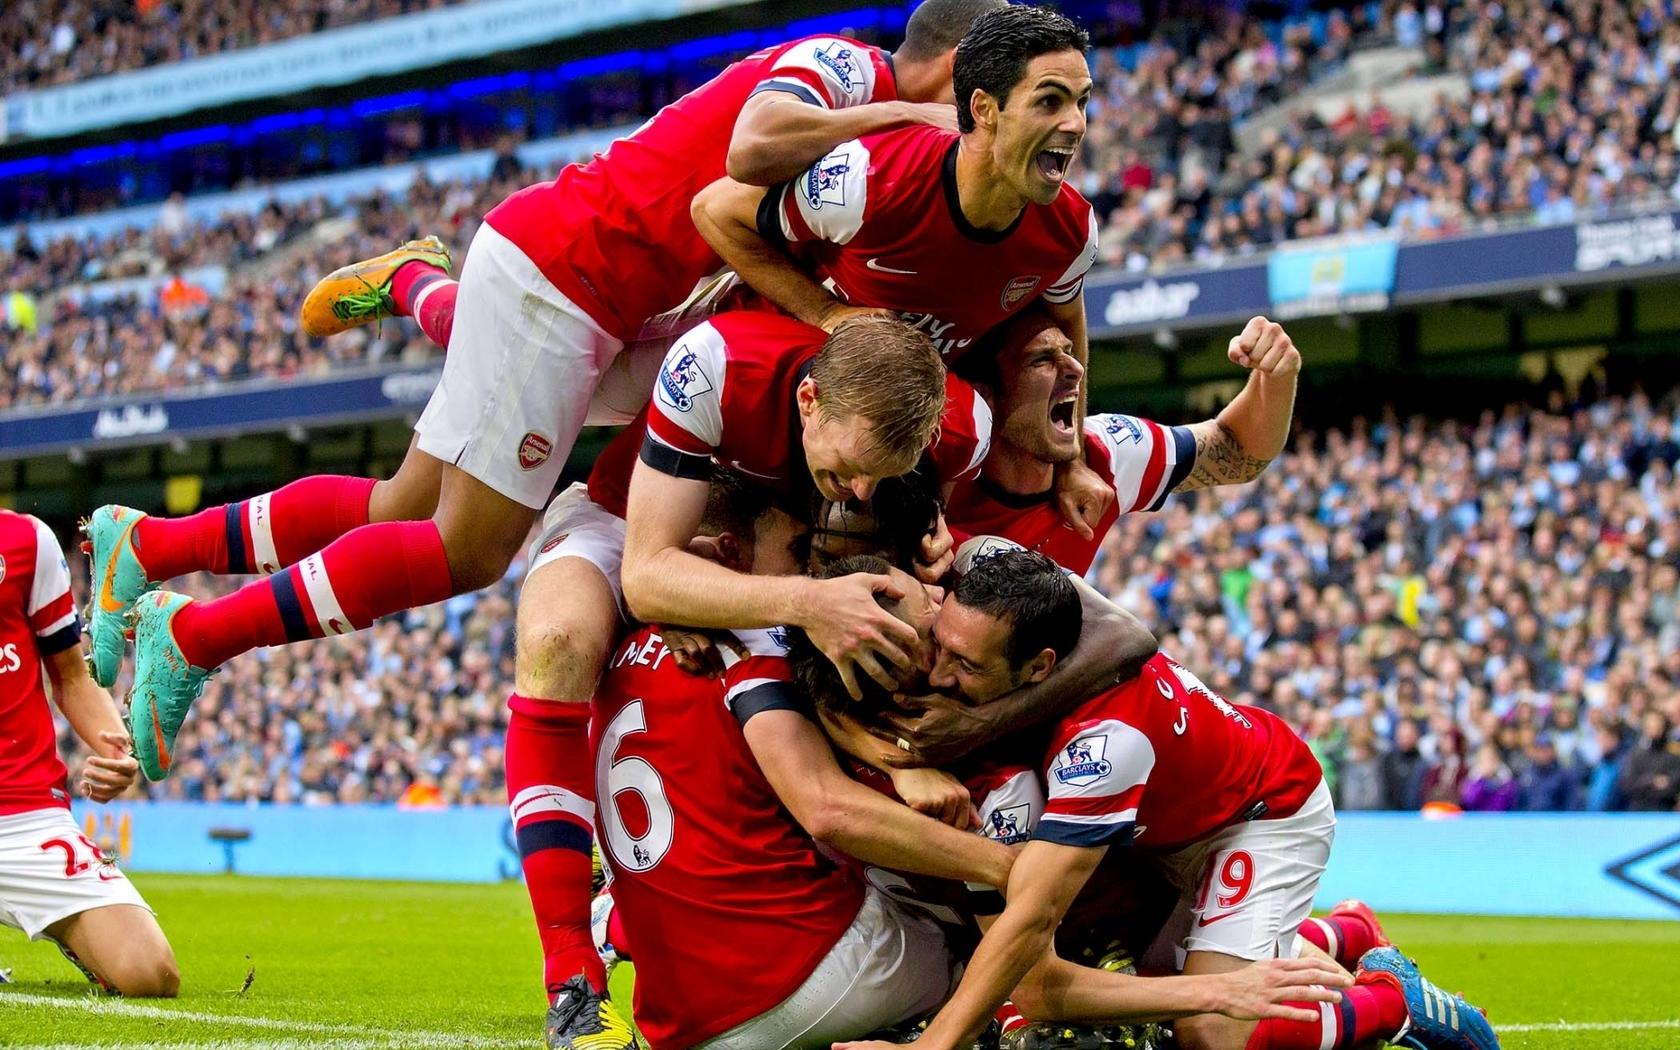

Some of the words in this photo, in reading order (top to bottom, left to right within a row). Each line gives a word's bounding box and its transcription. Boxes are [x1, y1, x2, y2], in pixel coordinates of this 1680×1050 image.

[608, 632, 672, 672] MEY
[593, 698, 675, 874] 6
[1062, 763, 1096, 777] BARCLAYS
